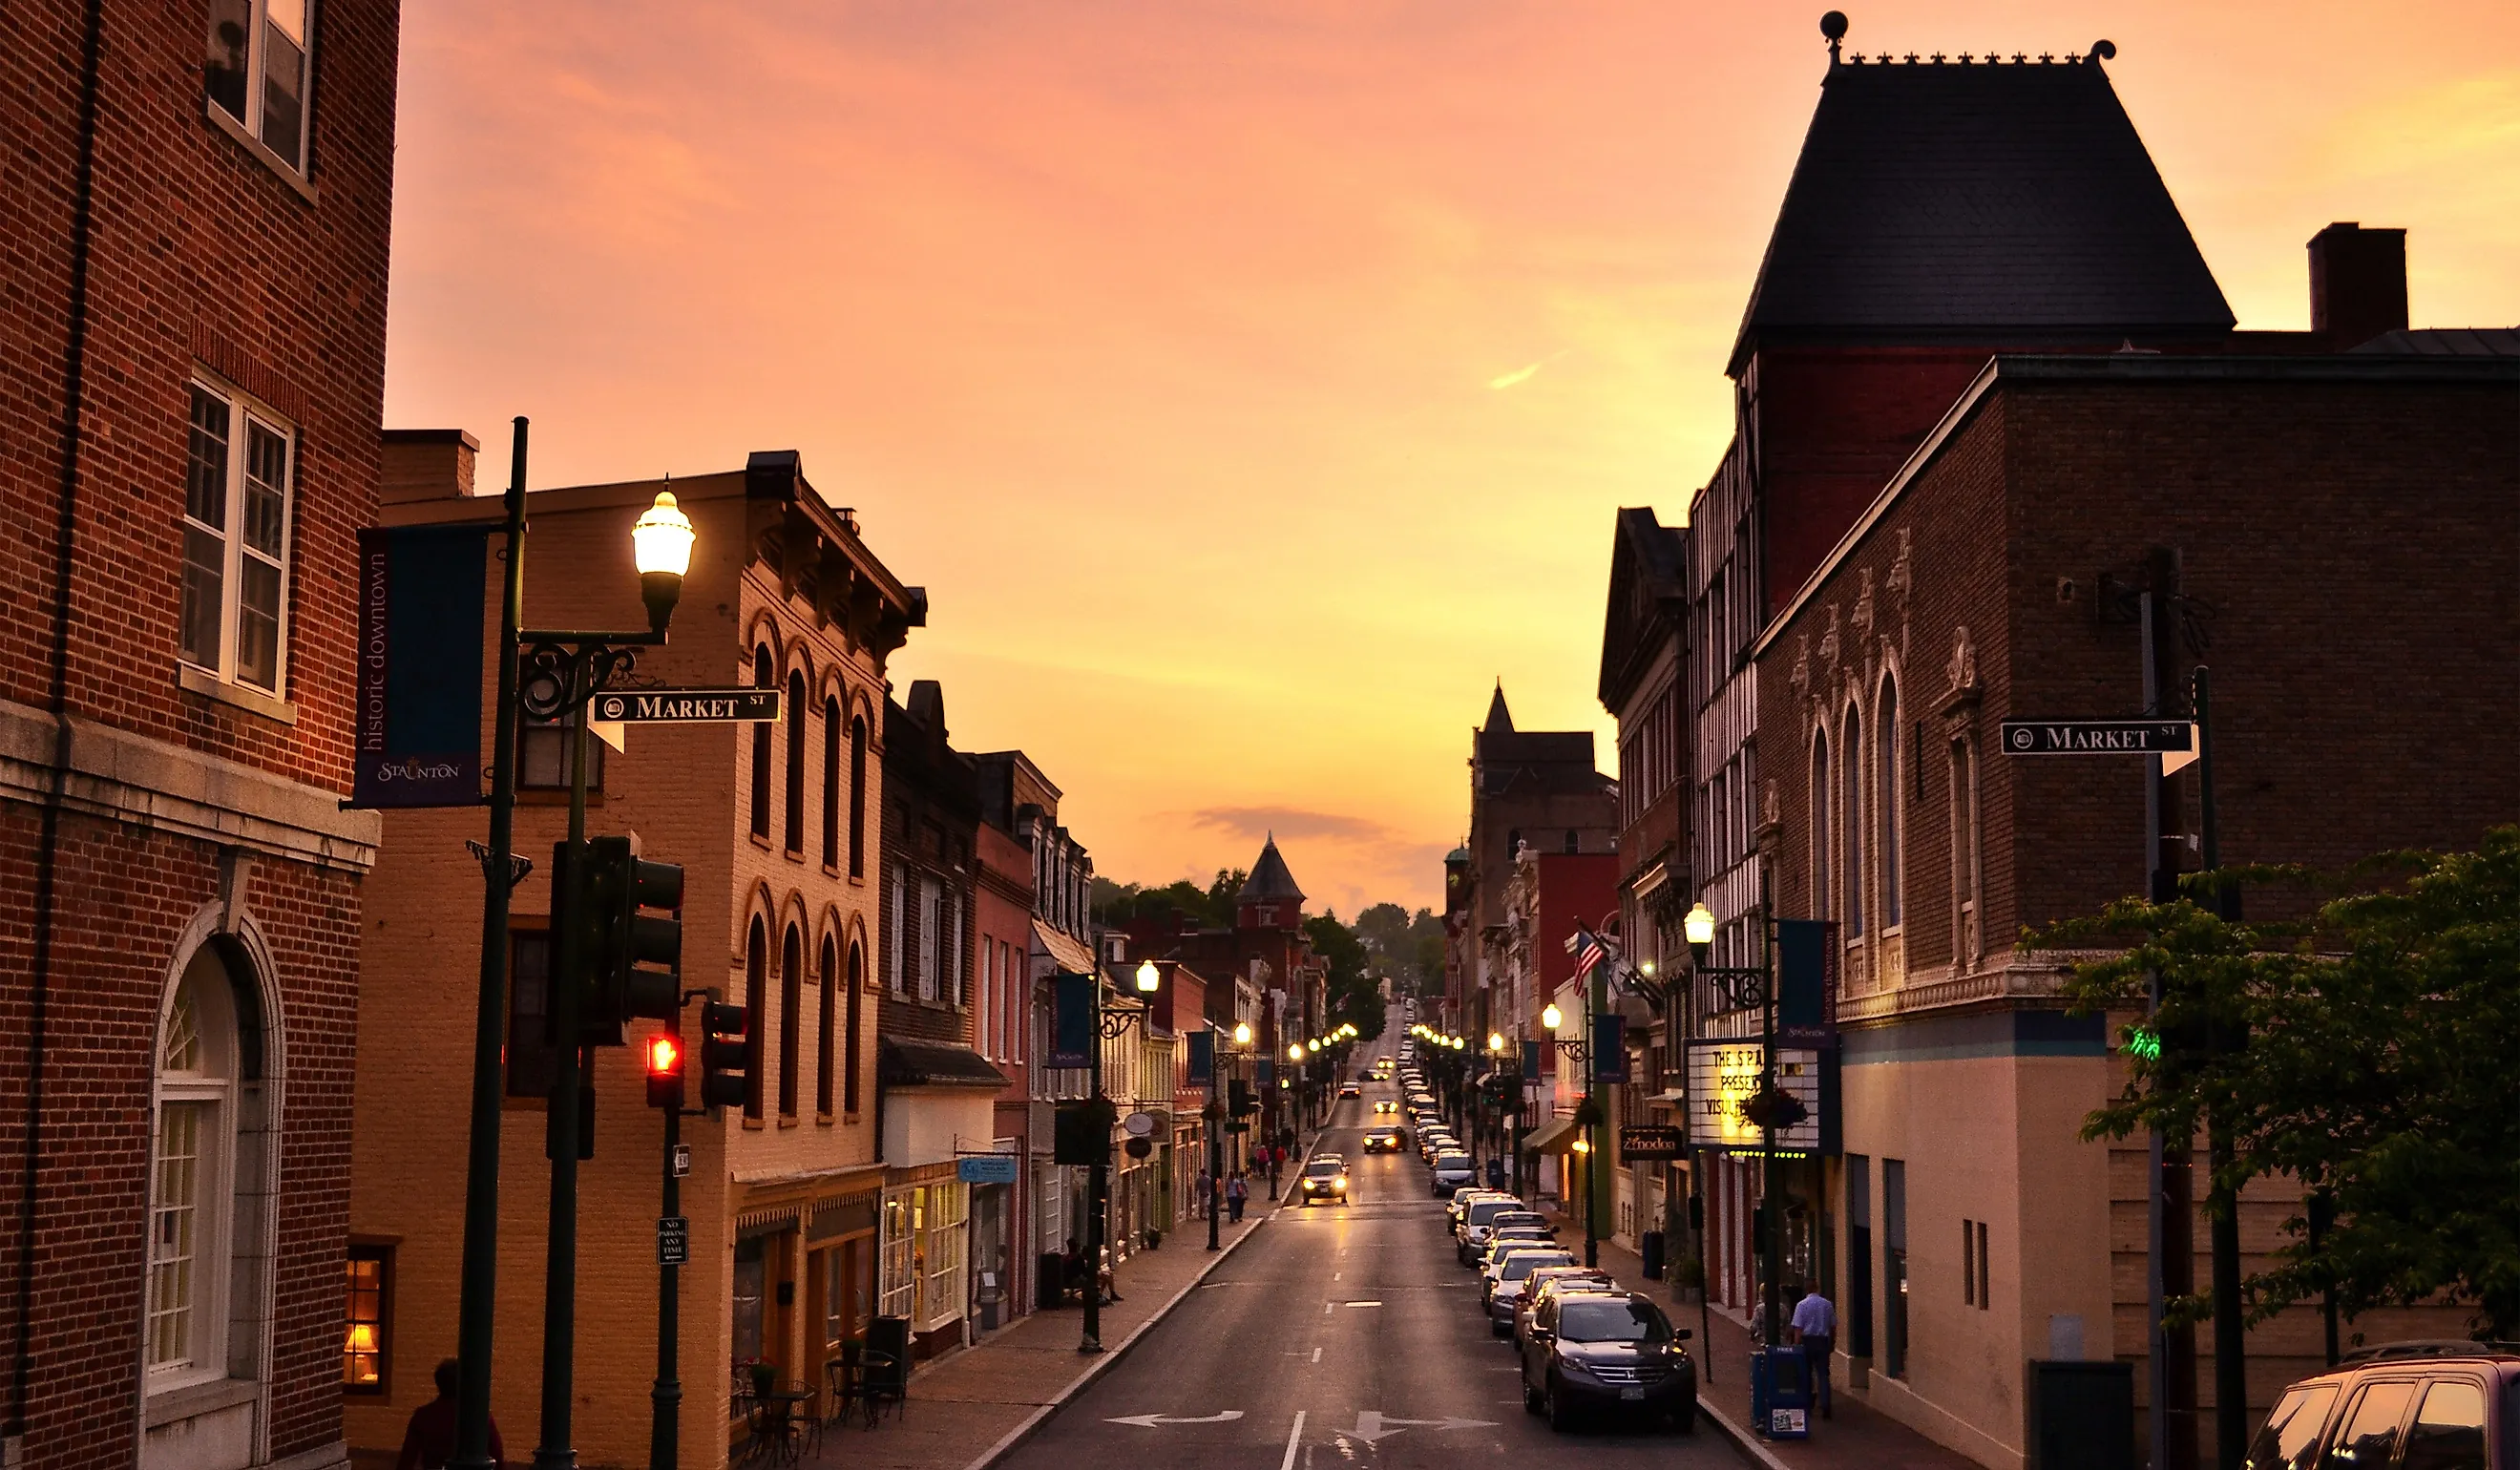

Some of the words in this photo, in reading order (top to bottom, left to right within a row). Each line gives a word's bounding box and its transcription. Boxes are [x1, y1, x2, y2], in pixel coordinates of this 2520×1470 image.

[367, 553, 387, 668] downtown
[364, 674, 385, 751] historic
[636, 696, 739, 720] MARKET
[749, 695, 766, 706] ST
[2046, 726, 2151, 749] MARKET
[2161, 725, 2177, 736] ST
[377, 761, 460, 783] STAUNTON
[1712, 1051, 1732, 1067] THE
